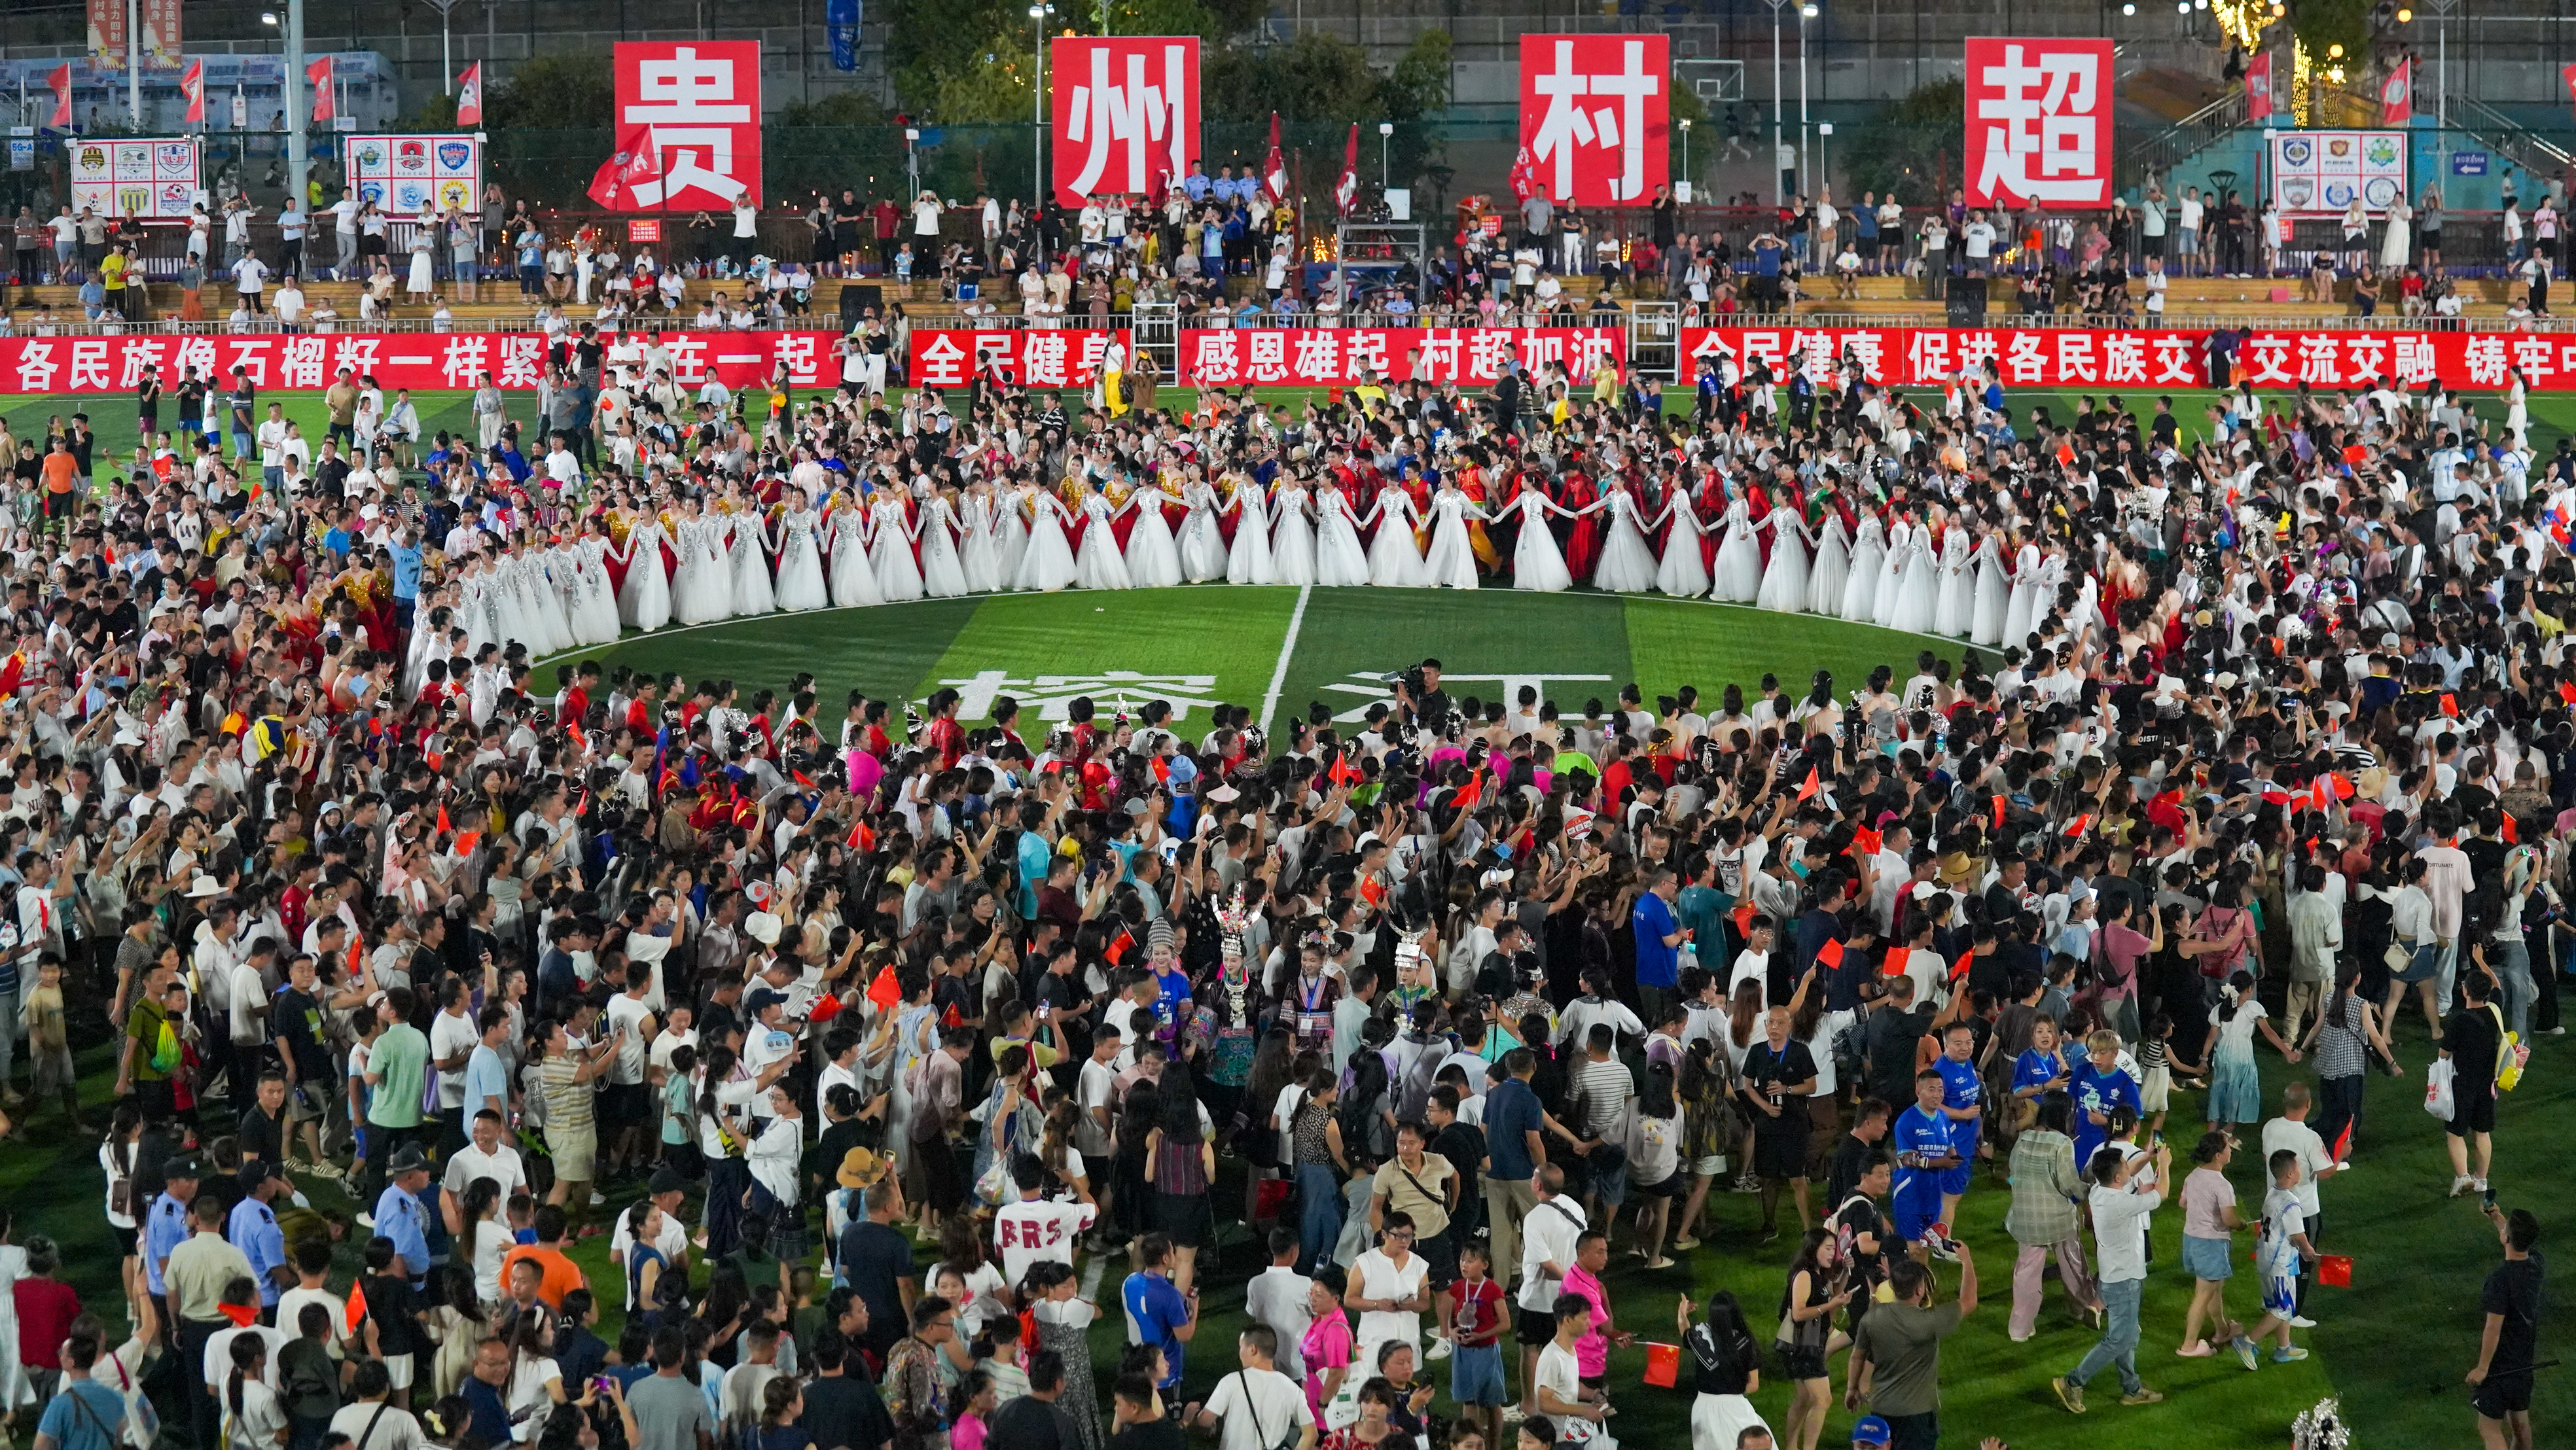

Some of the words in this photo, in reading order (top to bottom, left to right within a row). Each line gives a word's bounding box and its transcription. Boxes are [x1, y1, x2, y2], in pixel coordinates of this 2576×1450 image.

[165, 0, 176, 43] 全民健康
[625, 46, 751, 208] 贵
[1067, 44, 1185, 196] 州
[1533, 39, 1658, 202] 村
[1977, 44, 2104, 202] 超
[16, 334, 817, 391] 各民族像石榴籽一样紧在一起
[920, 332, 1111, 385] 全民健身
[1194, 330, 1390, 383] 感恩雄起
[1419, 328, 1613, 381] 村超加油
[1908, 331, 2437, 385] 促进各民族交交流交融
[408, 565, 420, 585] 7
[1000, 1217, 1062, 1249] BRS
